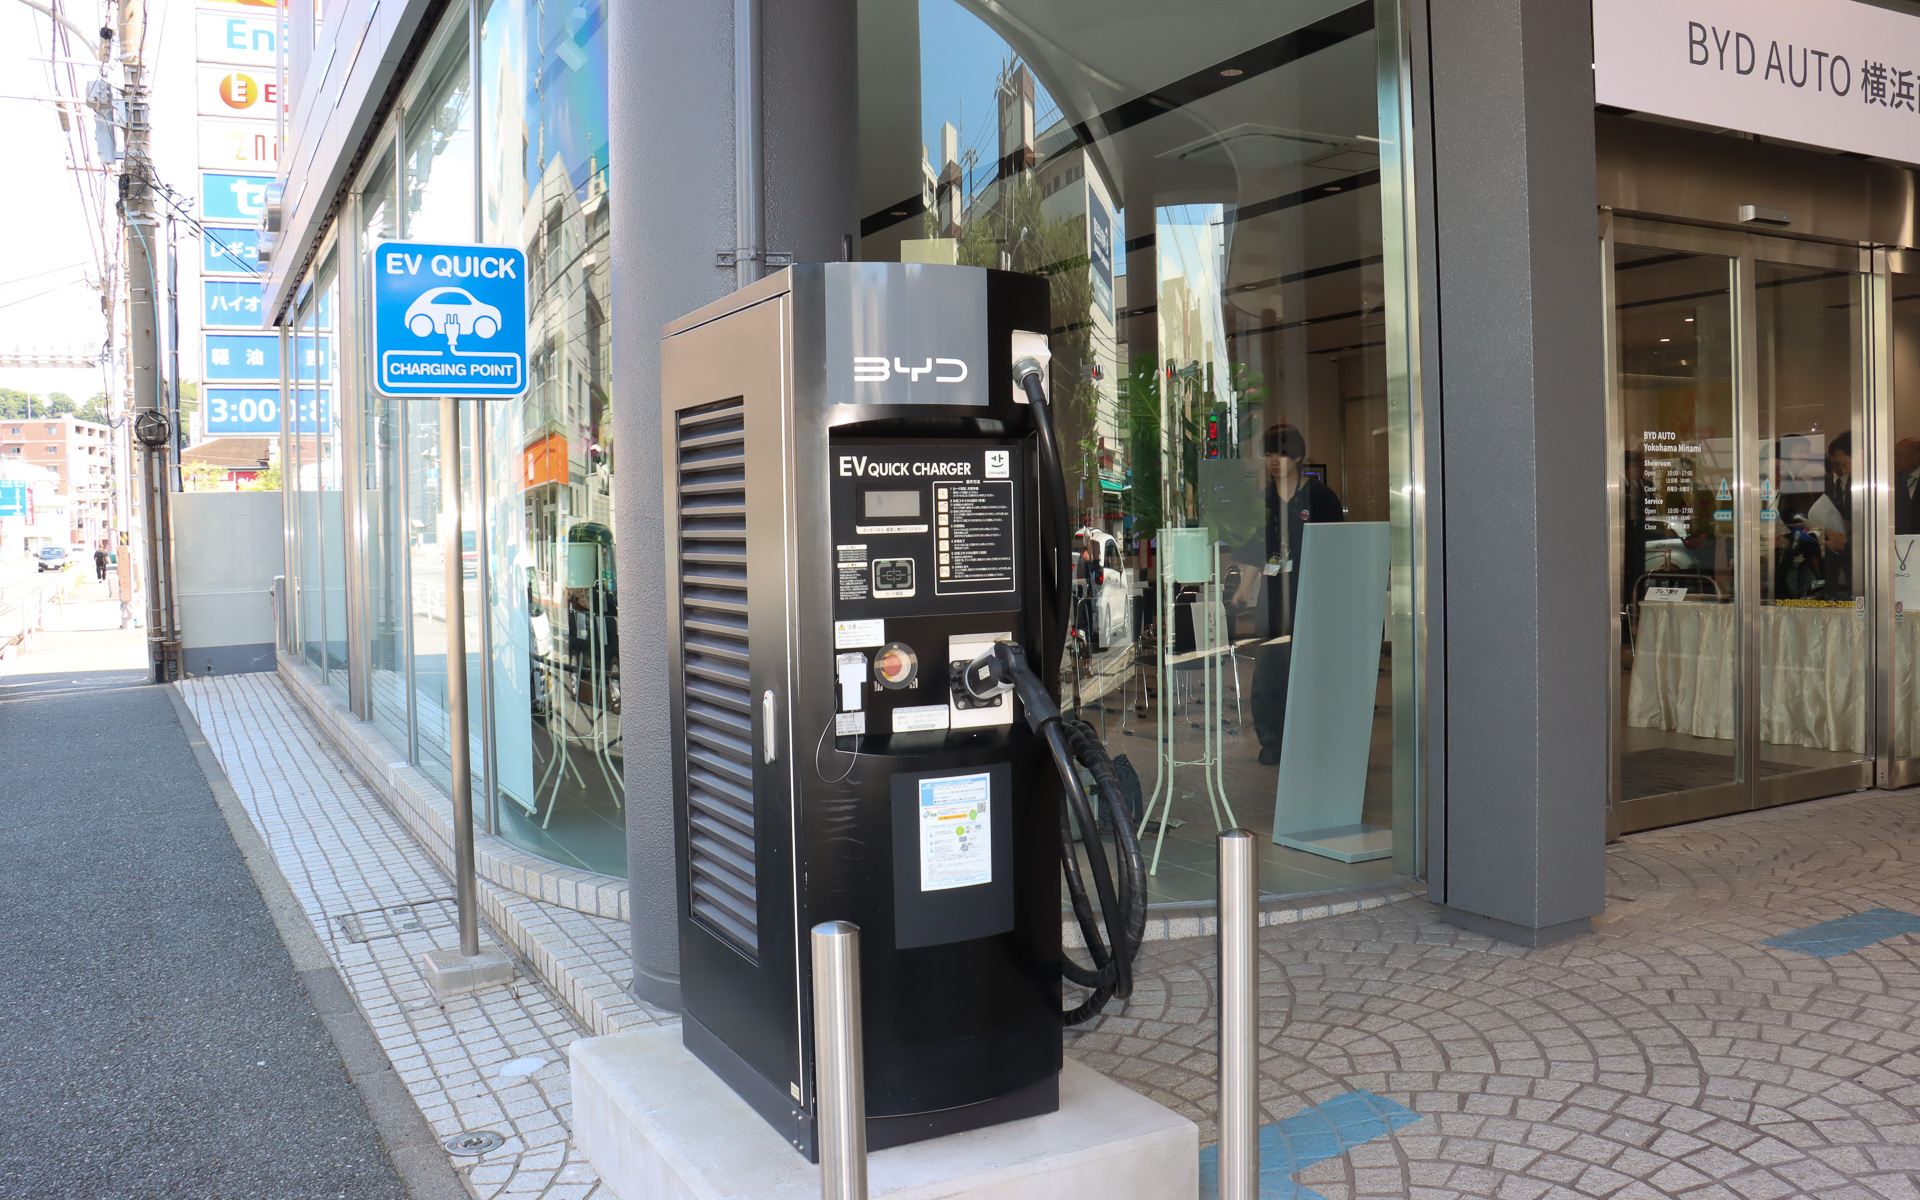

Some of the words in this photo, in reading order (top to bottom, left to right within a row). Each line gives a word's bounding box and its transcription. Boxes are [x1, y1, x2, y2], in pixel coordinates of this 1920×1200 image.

[1688, 20, 1756, 76] BYD
[1764, 40, 1851, 97] AUTO
[1860, 59, 1920, 114] 横浜
[386, 253, 423, 275] EV
[431, 254, 517, 279] QUICK
[389, 362, 467, 376] CHARGING
[470, 364, 514, 377] POINT
[853, 356, 968, 383] BYD
[211, 398, 281, 422] 3:00
[1643, 431, 1657, 440] BYD
[1657, 431, 1676, 440] AUTO
[1643, 443, 1678, 452] Yokohama
[1678, 443, 1702, 453] Minami
[839, 455, 868, 477] EV
[868, 462, 910, 478] QUICK
[912, 462, 972, 476] CHARGER
